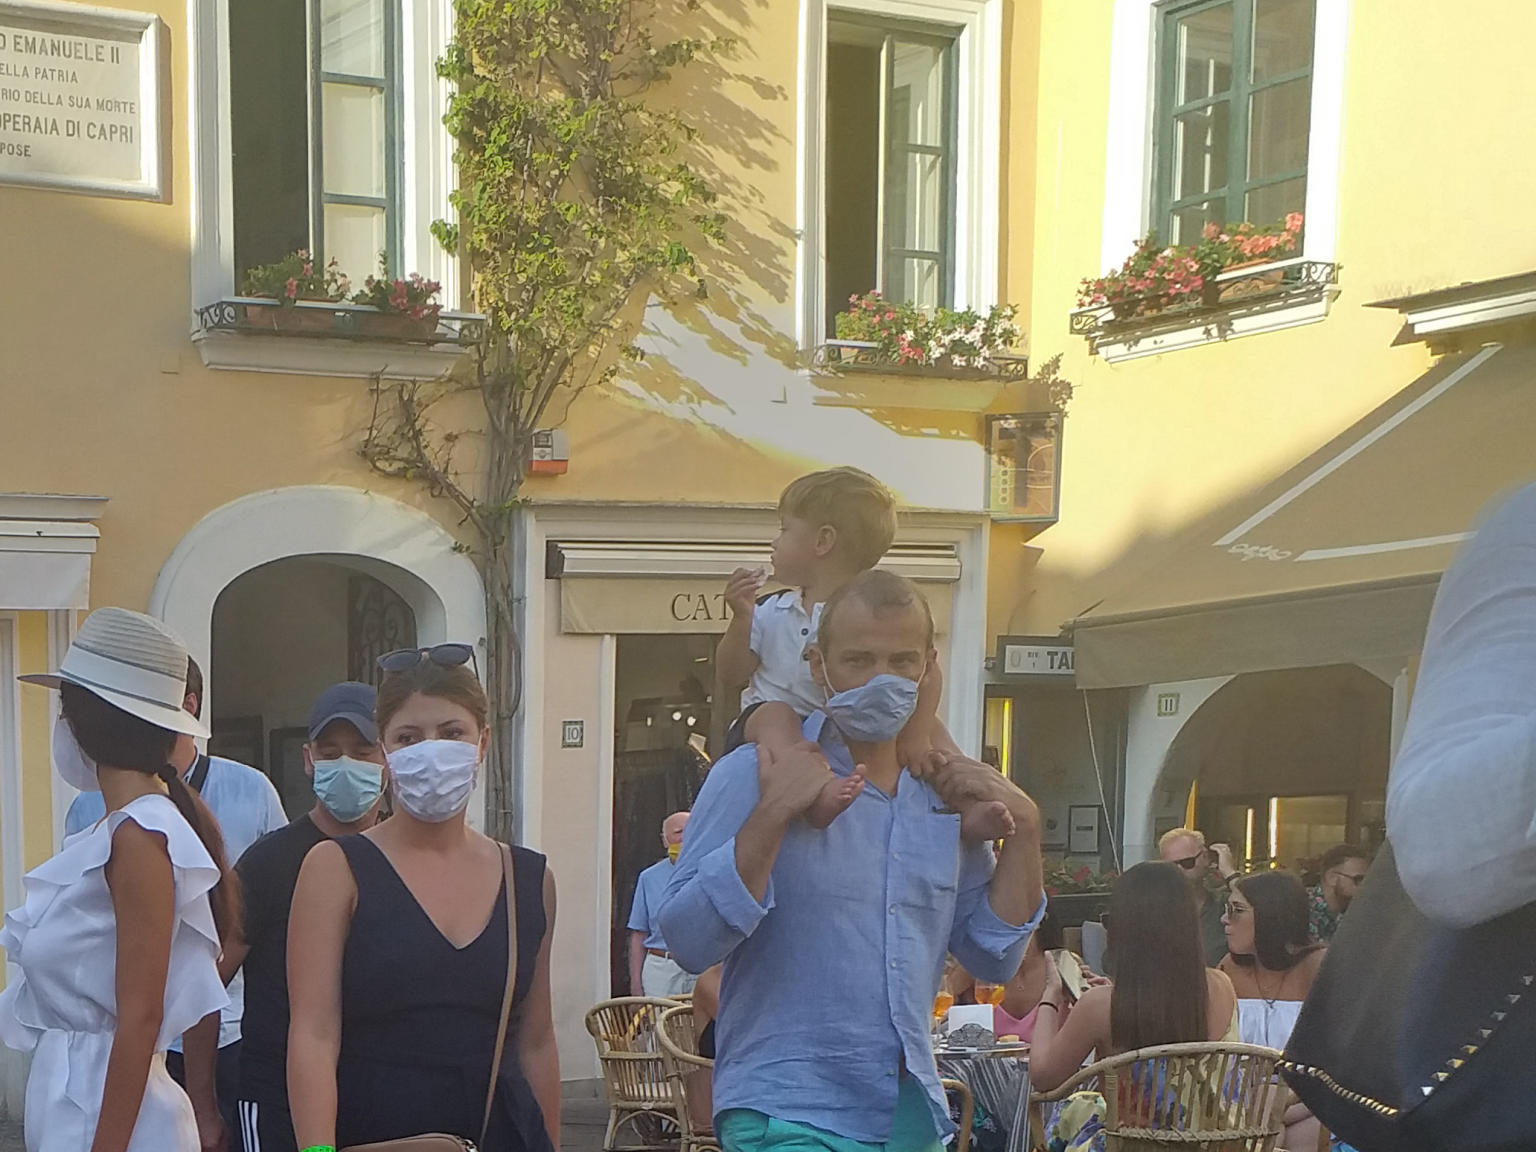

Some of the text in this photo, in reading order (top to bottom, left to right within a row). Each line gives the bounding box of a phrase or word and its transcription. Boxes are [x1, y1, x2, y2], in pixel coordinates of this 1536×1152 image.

[13, 34, 105, 62] EMANUELE
[110, 46, 120, 64] II
[34, 67, 78, 84] PATRIA
[24, 89, 63, 107] DELLA
[67, 95, 92, 110] SUA
[95, 99, 136, 114] MORTE
[66, 119, 80, 138] DI
[86, 123, 134, 144] CAPRI
[0, 142, 31, 158] POSE
[567, 727, 579, 740] 10
